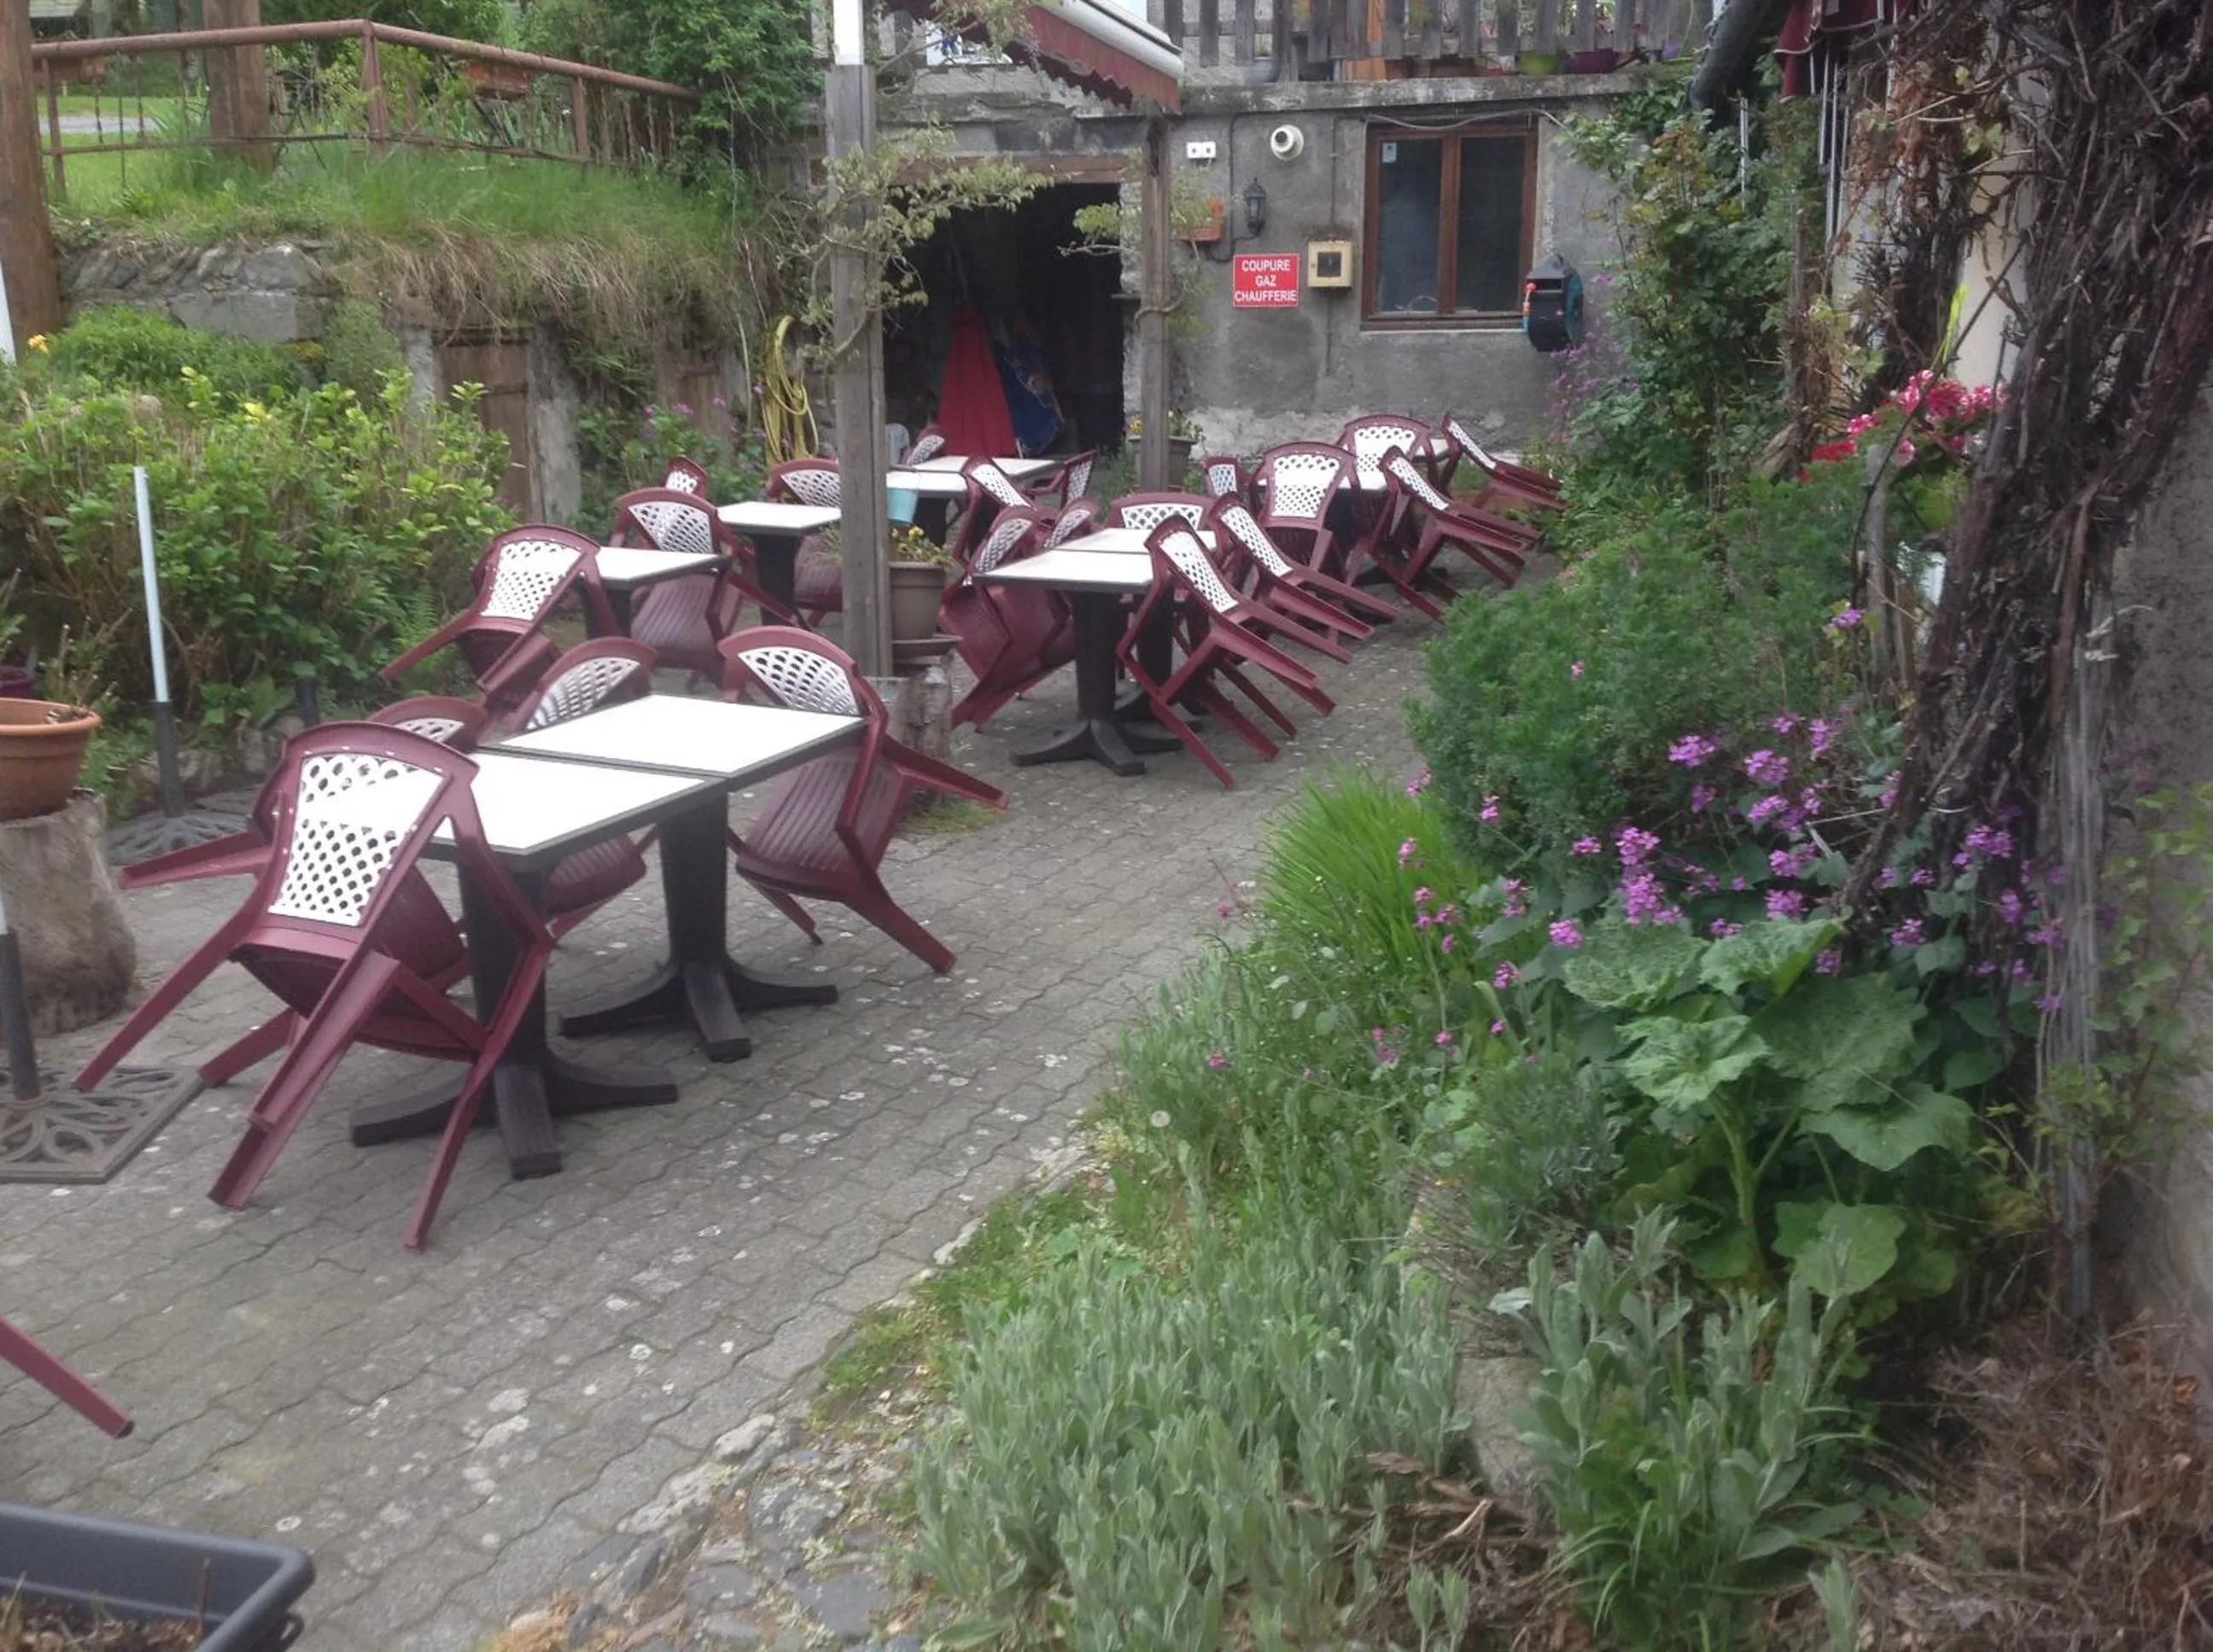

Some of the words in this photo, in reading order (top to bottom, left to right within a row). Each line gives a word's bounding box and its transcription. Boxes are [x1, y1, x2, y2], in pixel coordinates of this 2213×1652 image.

[1241, 260, 1291, 271] COUPURE
[1255, 275, 1277, 287] GAZ
[1235, 290, 1297, 301] CHAUFFERIE
